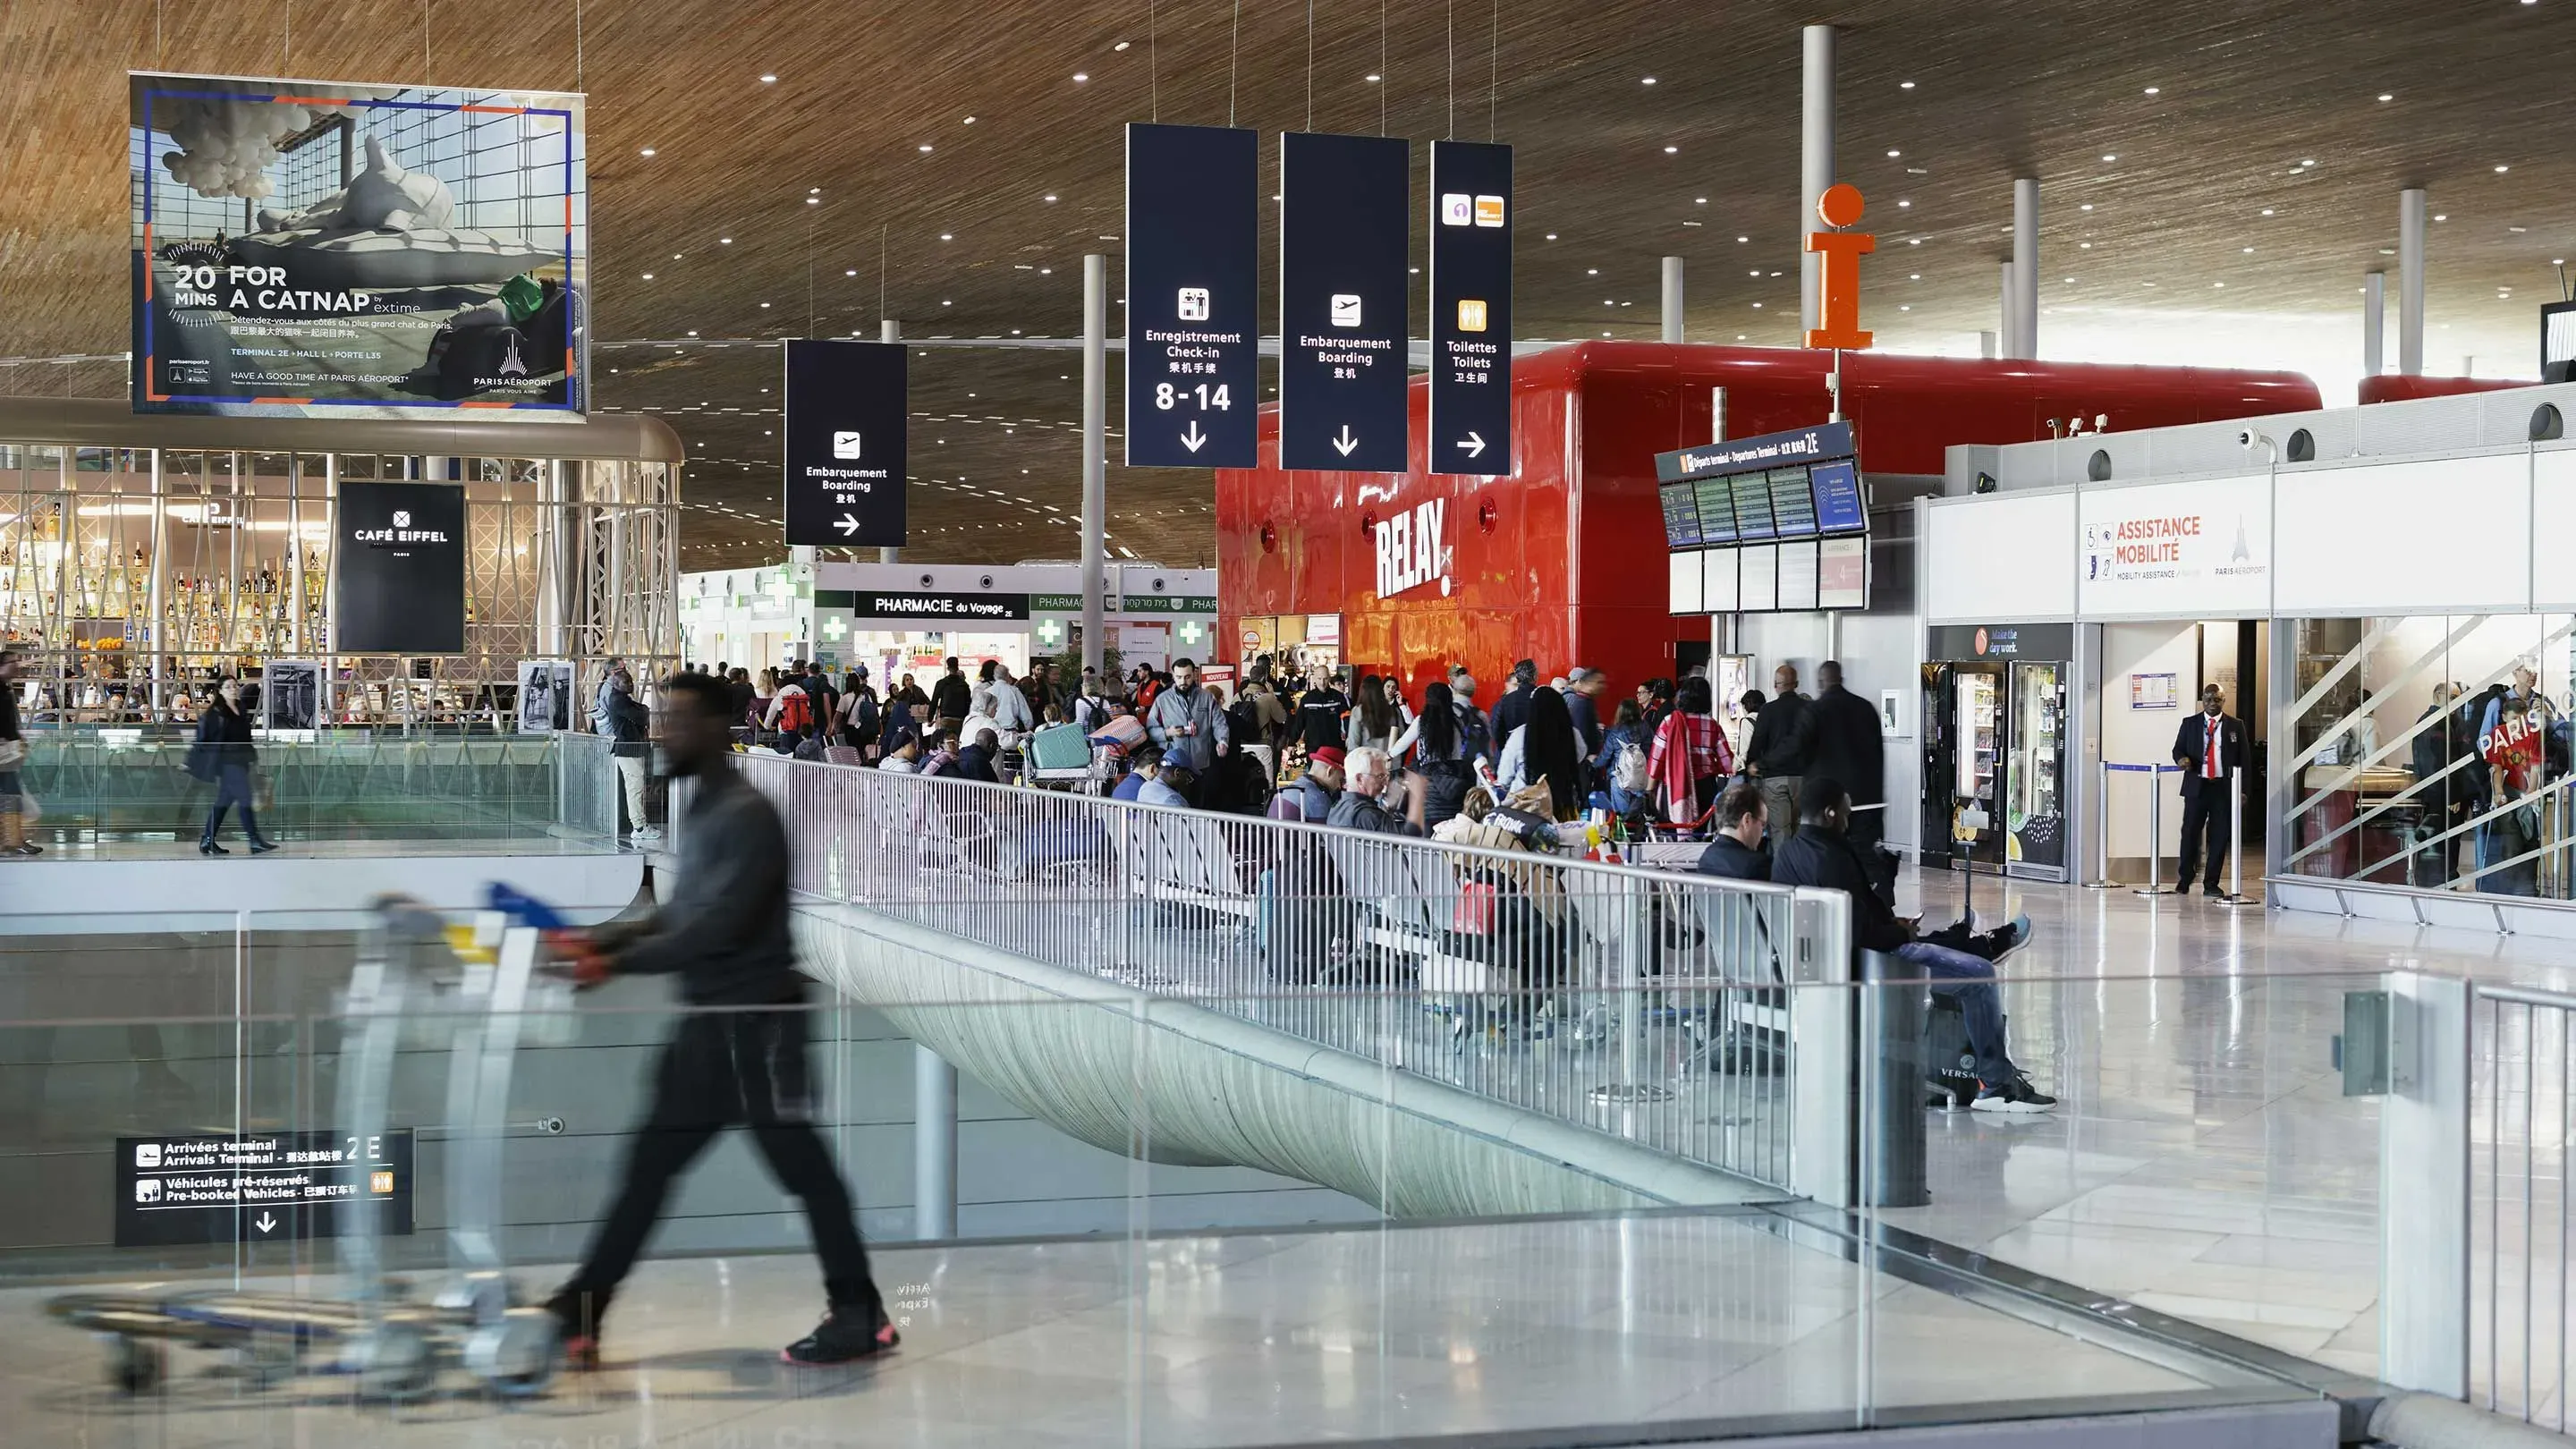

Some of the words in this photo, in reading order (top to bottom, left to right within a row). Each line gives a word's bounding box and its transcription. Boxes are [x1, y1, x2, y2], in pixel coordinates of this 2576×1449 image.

[175, 266, 216, 290] 20
[230, 266, 287, 286] FOR
[175, 292, 217, 306] MINS
[229, 289, 250, 309] A
[258, 290, 370, 312] CATNAP
[374, 301, 421, 313] extime
[231, 316, 294, 325] Détendez-vous
[314, 318, 336, 326] côtés
[352, 319, 369, 329] plus
[371, 320, 395, 329] grand
[397, 320, 416, 329] chat
[418, 321, 428, 329] de
[1146, 329, 1241, 344] Enregistrement
[1300, 335, 1392, 350] Embarquement
[231, 348, 275, 357] TERMINAL
[297, 350, 319, 358] HALL
[335, 351, 364, 359] PORTE
[1166, 345, 1220, 358] Check-in
[1446, 341, 1497, 353] Toilettes
[1318, 352, 1373, 367] Boarding
[1453, 356, 1491, 369] Toilets
[1169, 361, 1216, 374] 乘机手续
[1334, 367, 1357, 379] 登机
[266, 372, 293, 380] GOOD
[295, 373, 316, 381] TIME
[331, 374, 356, 382] PARIS
[1454, 371, 1487, 384] 卫生间
[1805, 432, 1819, 454] 2E
[806, 466, 887, 479] Embarquement
[822, 479, 871, 493] Boarding
[355, 528, 394, 541] CAFÉ
[398, 530, 448, 542] EIFFEL
[2117, 516, 2200, 540] ASSISTANCE
[2116, 538, 2180, 564] MOBILITÉ
[2117, 571, 2141, 580] MOBILITY
[2142, 570, 2174, 580] ASSISTANCE
[876, 597, 953, 613] PHARMACIE
[955, 603, 968, 613] du
[970, 602, 1004, 615] Voyage
[1992, 629, 2006, 640] Make
[2007, 629, 2017, 640] the
[1989, 642, 2001, 656] day
[1206, 673, 1229, 681] NOUVEAU
[2479, 708, 2541, 759] PARIS
[165, 1141, 219, 1154] Arrivées
[223, 1139, 276, 1151] terminal
[165, 1154, 216, 1166] Arrivals
[218, 1152, 274, 1164] Terminal
[165, 1175, 228, 1189] Véhicules
[233, 1174, 309, 1190] pré-réservés
[166, 1189, 241, 1201] Pre-booked
